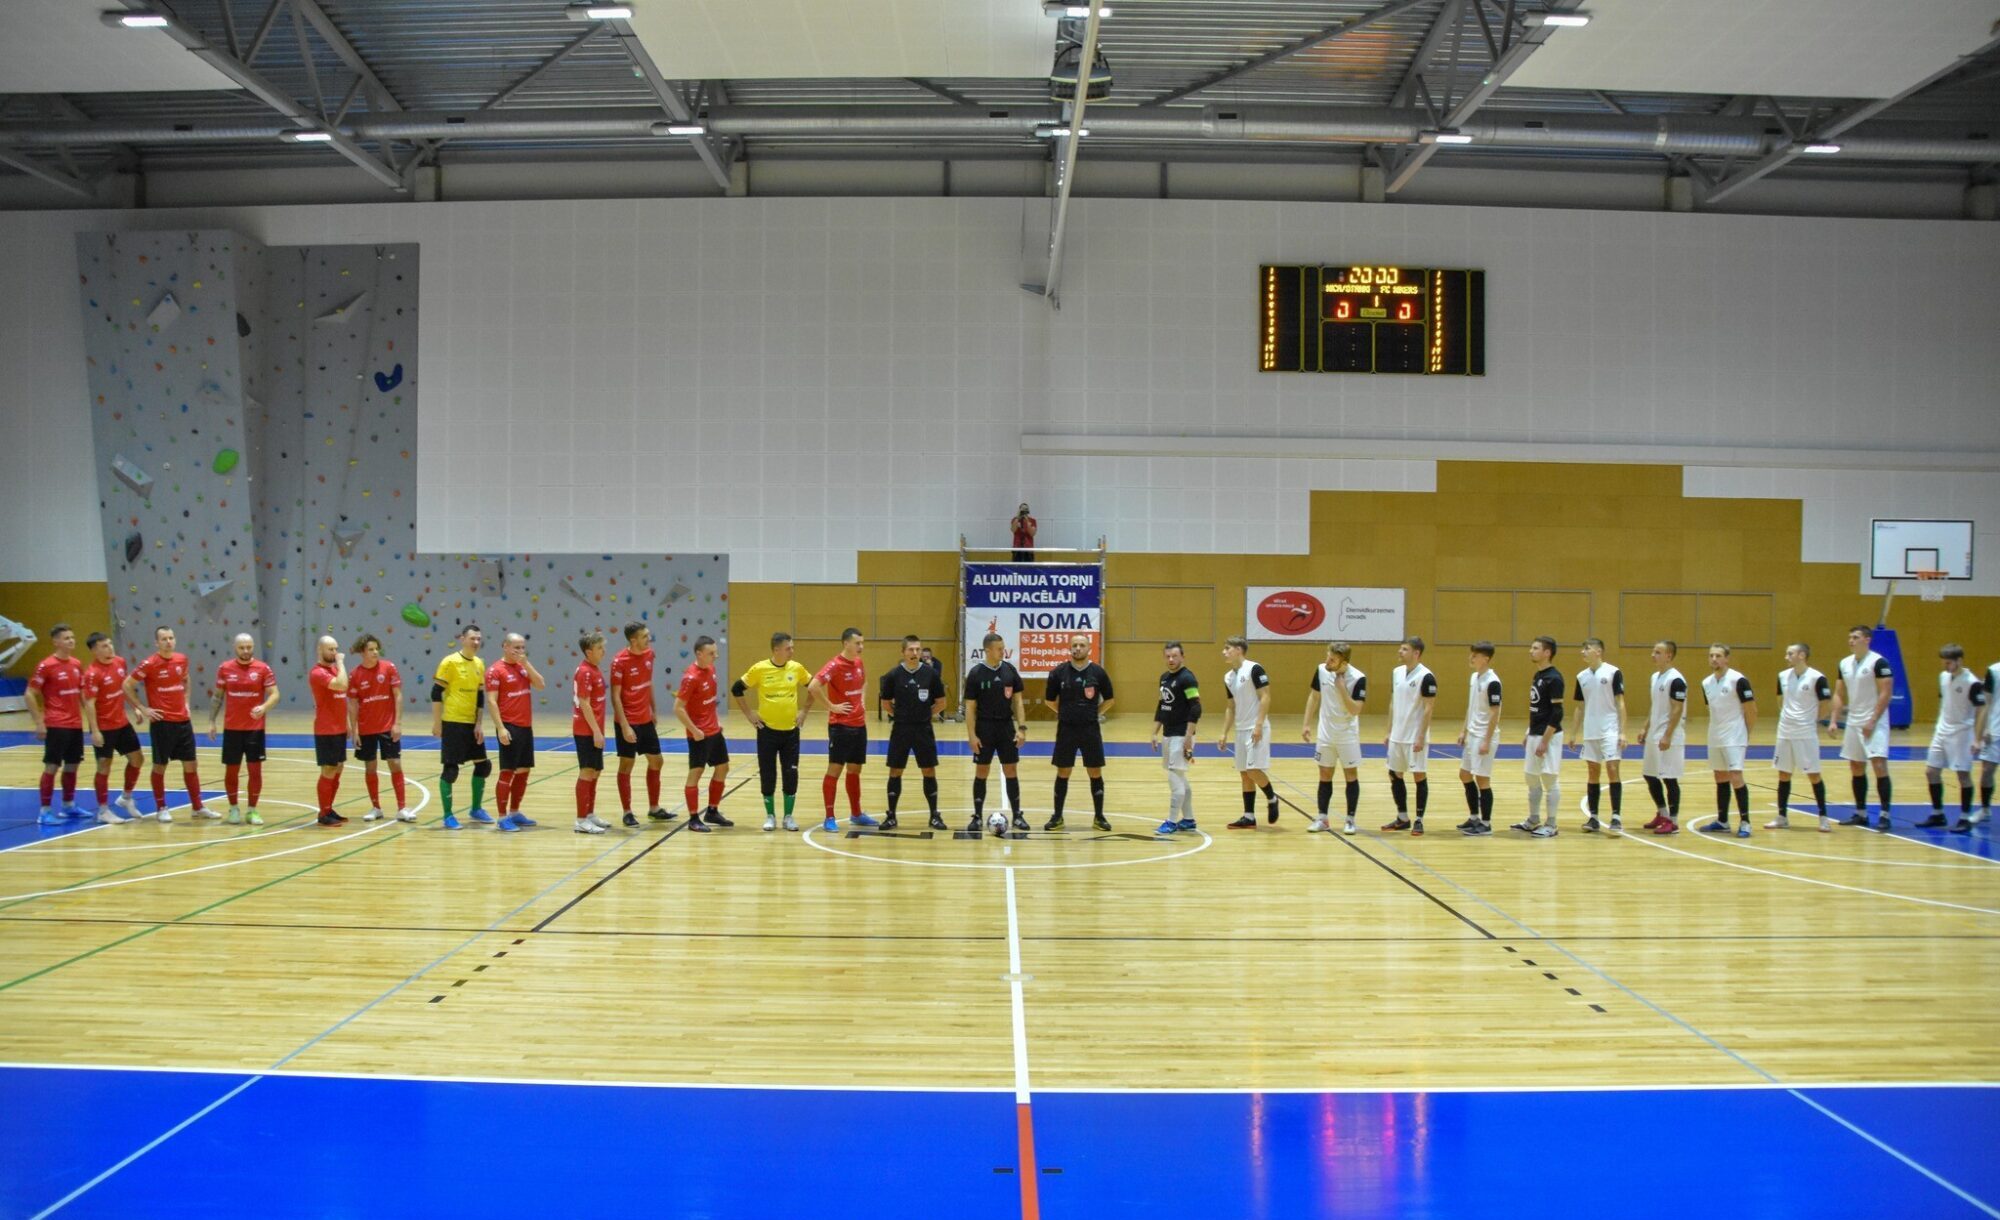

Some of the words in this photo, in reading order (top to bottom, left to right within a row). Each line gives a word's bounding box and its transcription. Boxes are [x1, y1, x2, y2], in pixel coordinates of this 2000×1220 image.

[972, 573, 1048, 586] ALUMĪNIJA
[1050, 574, 1093, 589] TORŅI
[989, 592, 1010, 603] UN
[1012, 590, 1077, 603] PACĒLĀJI
[1019, 613, 1093, 629] NOMA
[1031, 634, 1045, 643] 25
[1049, 634, 1069, 643] 151
